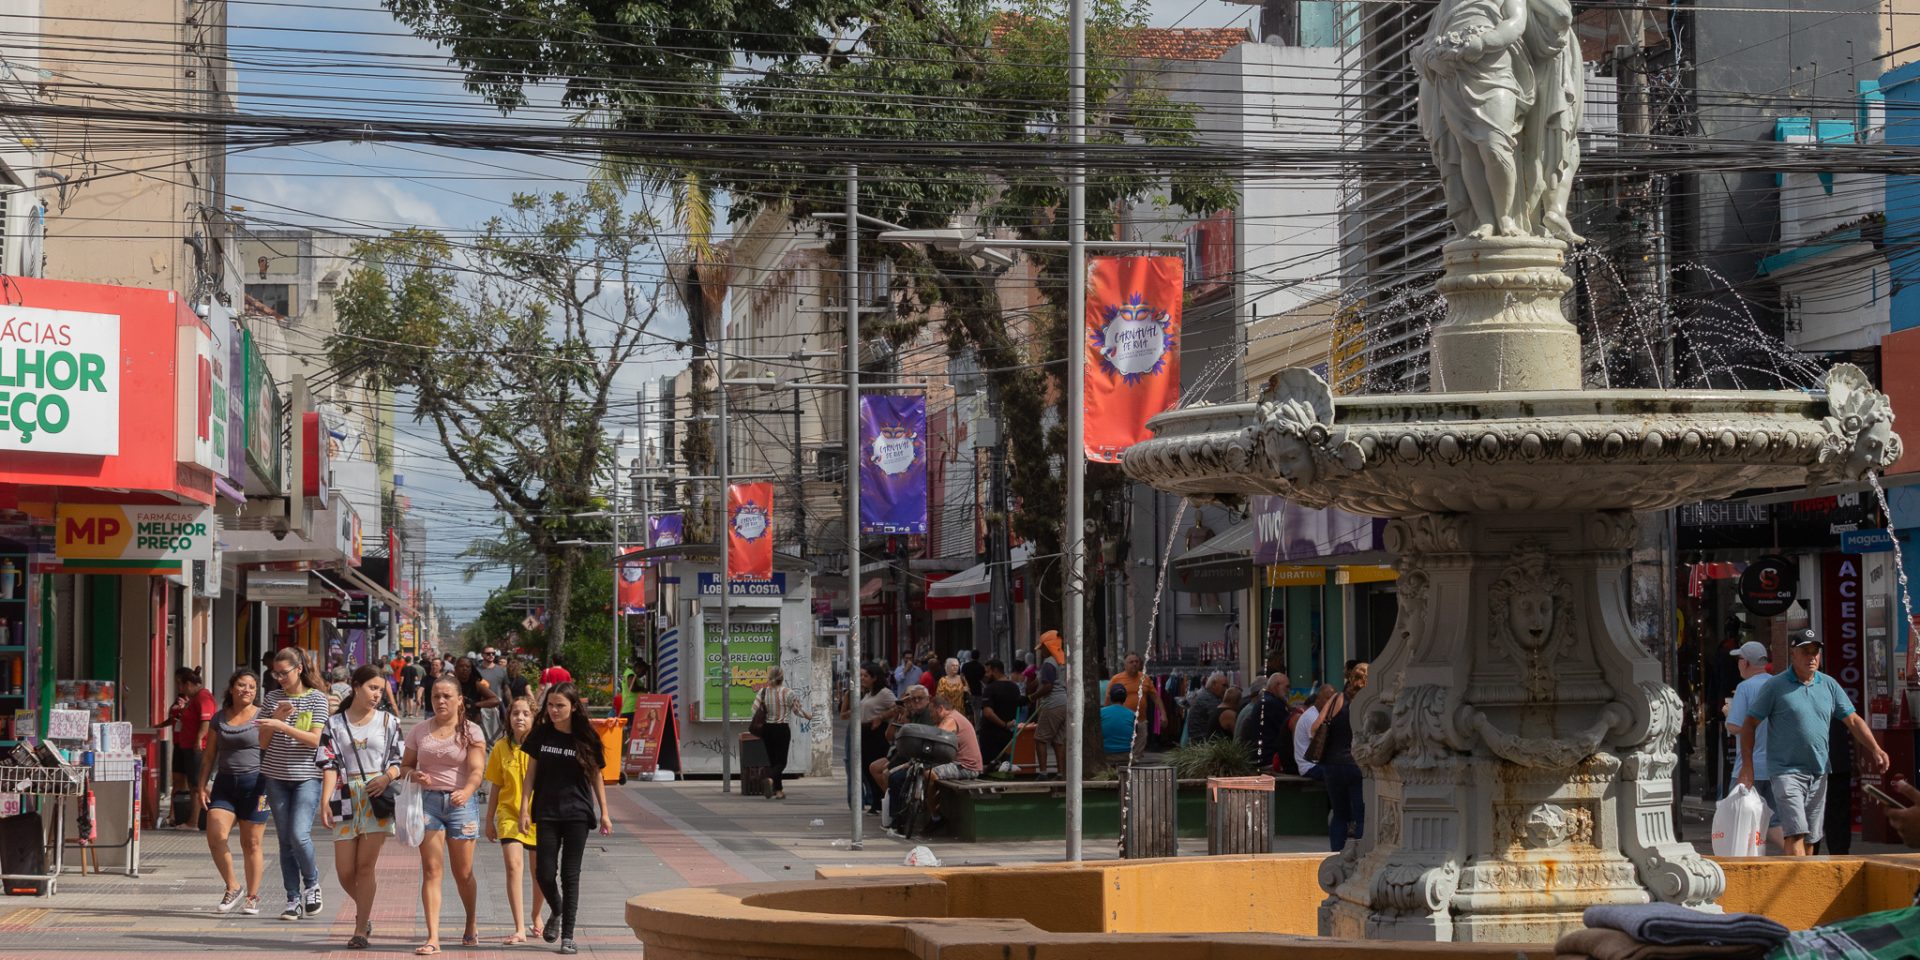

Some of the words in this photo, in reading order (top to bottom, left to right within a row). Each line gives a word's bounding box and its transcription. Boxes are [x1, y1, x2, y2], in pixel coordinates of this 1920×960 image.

[0, 317, 72, 346] ÁCIAS
[1114, 324, 1159, 343] CARNAVAL
[137, 512, 193, 521] FARMÁCIAS
[1682, 503, 1730, 523] FINISH
[1735, 502, 1768, 522] LINE
[65, 517, 120, 545] MP
[137, 522, 207, 536] MELHOR
[137, 536, 192, 553] PREÇO
[733, 584, 747, 593] DA
[749, 584, 781, 594] COSTA
[709, 625, 774, 633] REISTARIA
[708, 654, 748, 662] COPRE
[750, 654, 774, 662] AQUI
[50, 711, 88, 725] PROMOÇÃO
